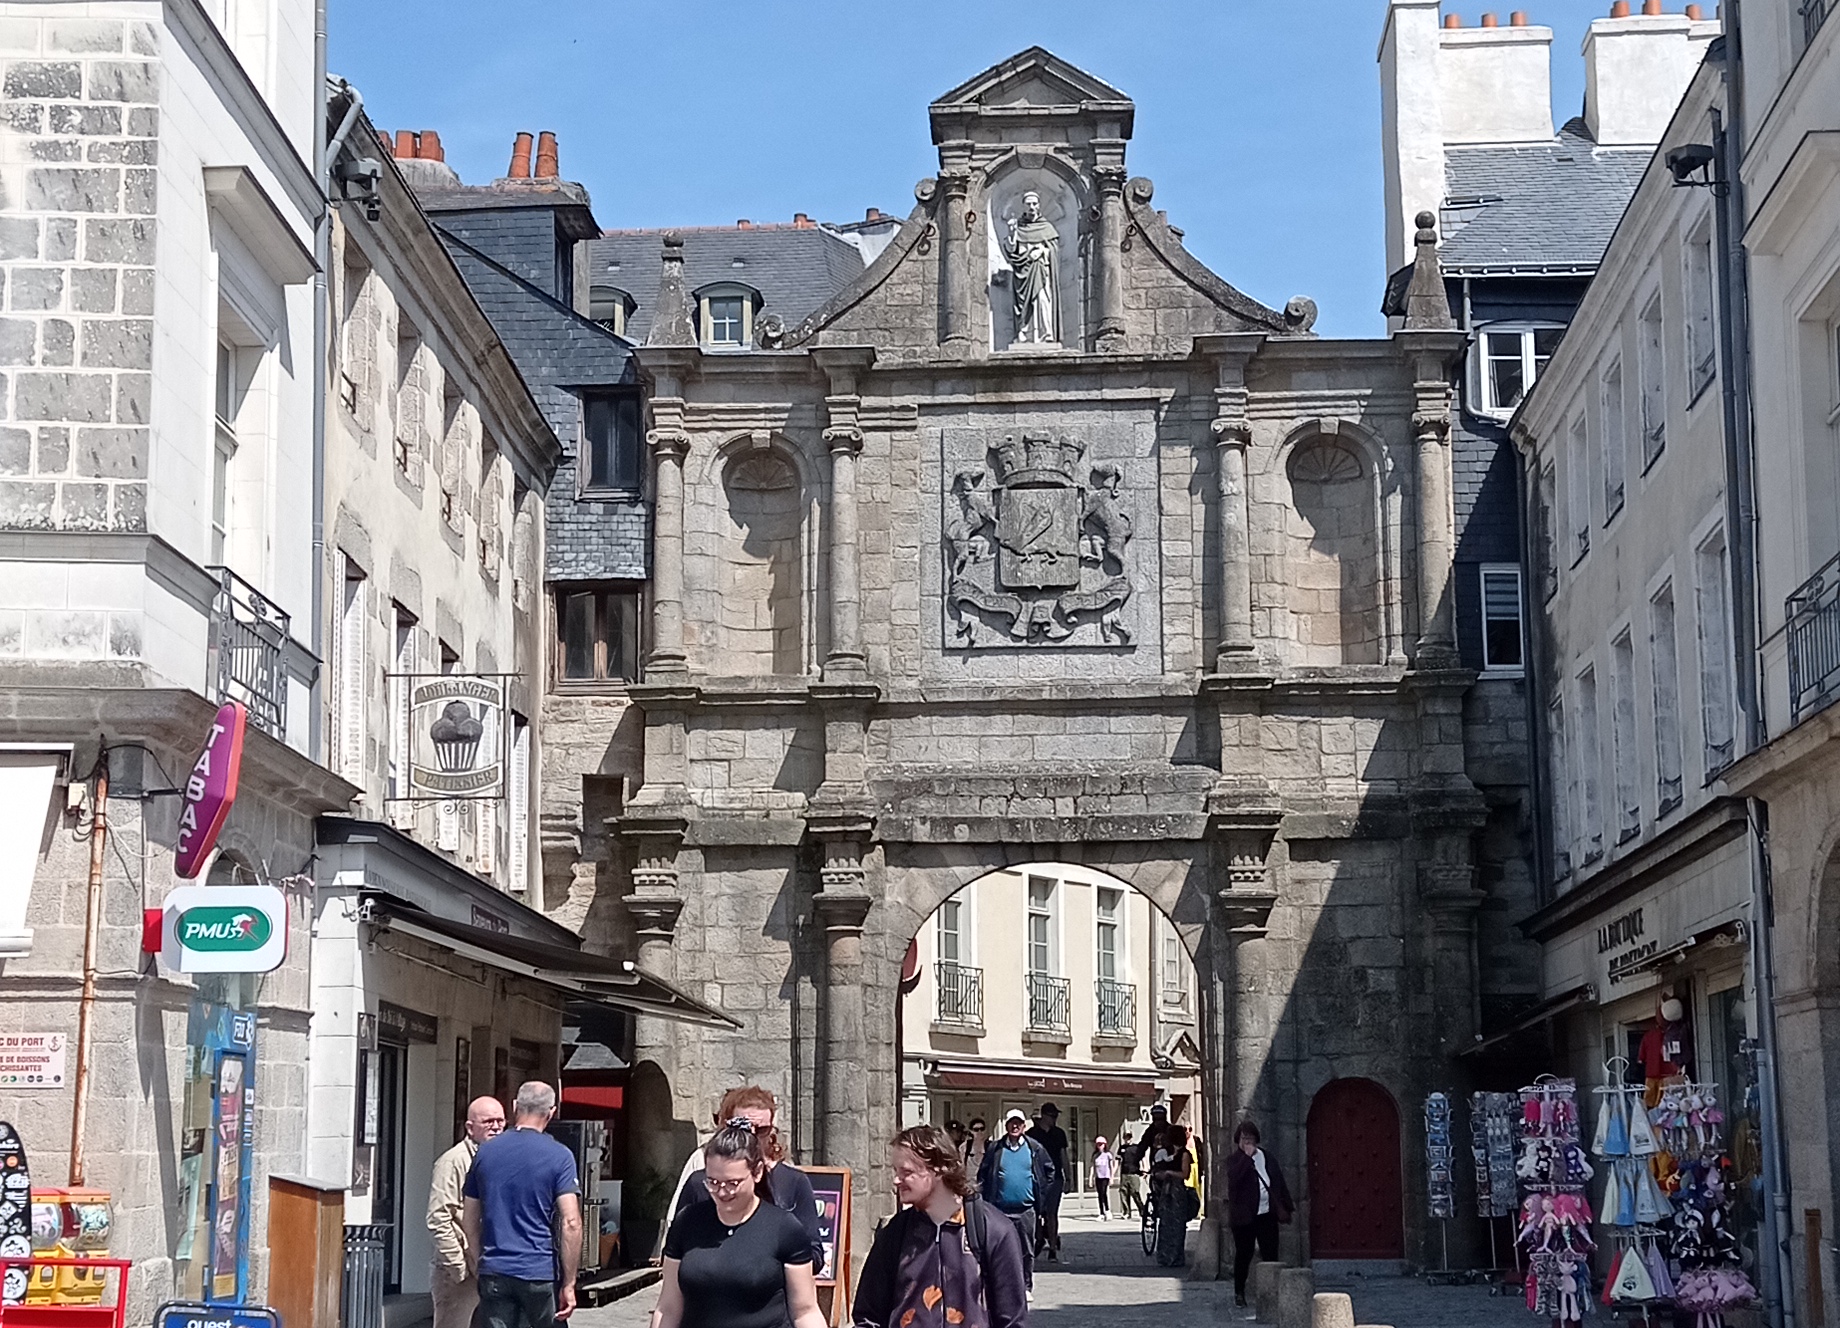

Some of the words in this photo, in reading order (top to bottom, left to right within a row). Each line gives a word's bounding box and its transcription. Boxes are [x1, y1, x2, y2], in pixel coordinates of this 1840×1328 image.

[176, 724, 225, 855] TABAC
[185, 922, 231, 939] PMU
[7, 1038, 19, 1046] DU
[22, 1038, 44, 1046] PORT
